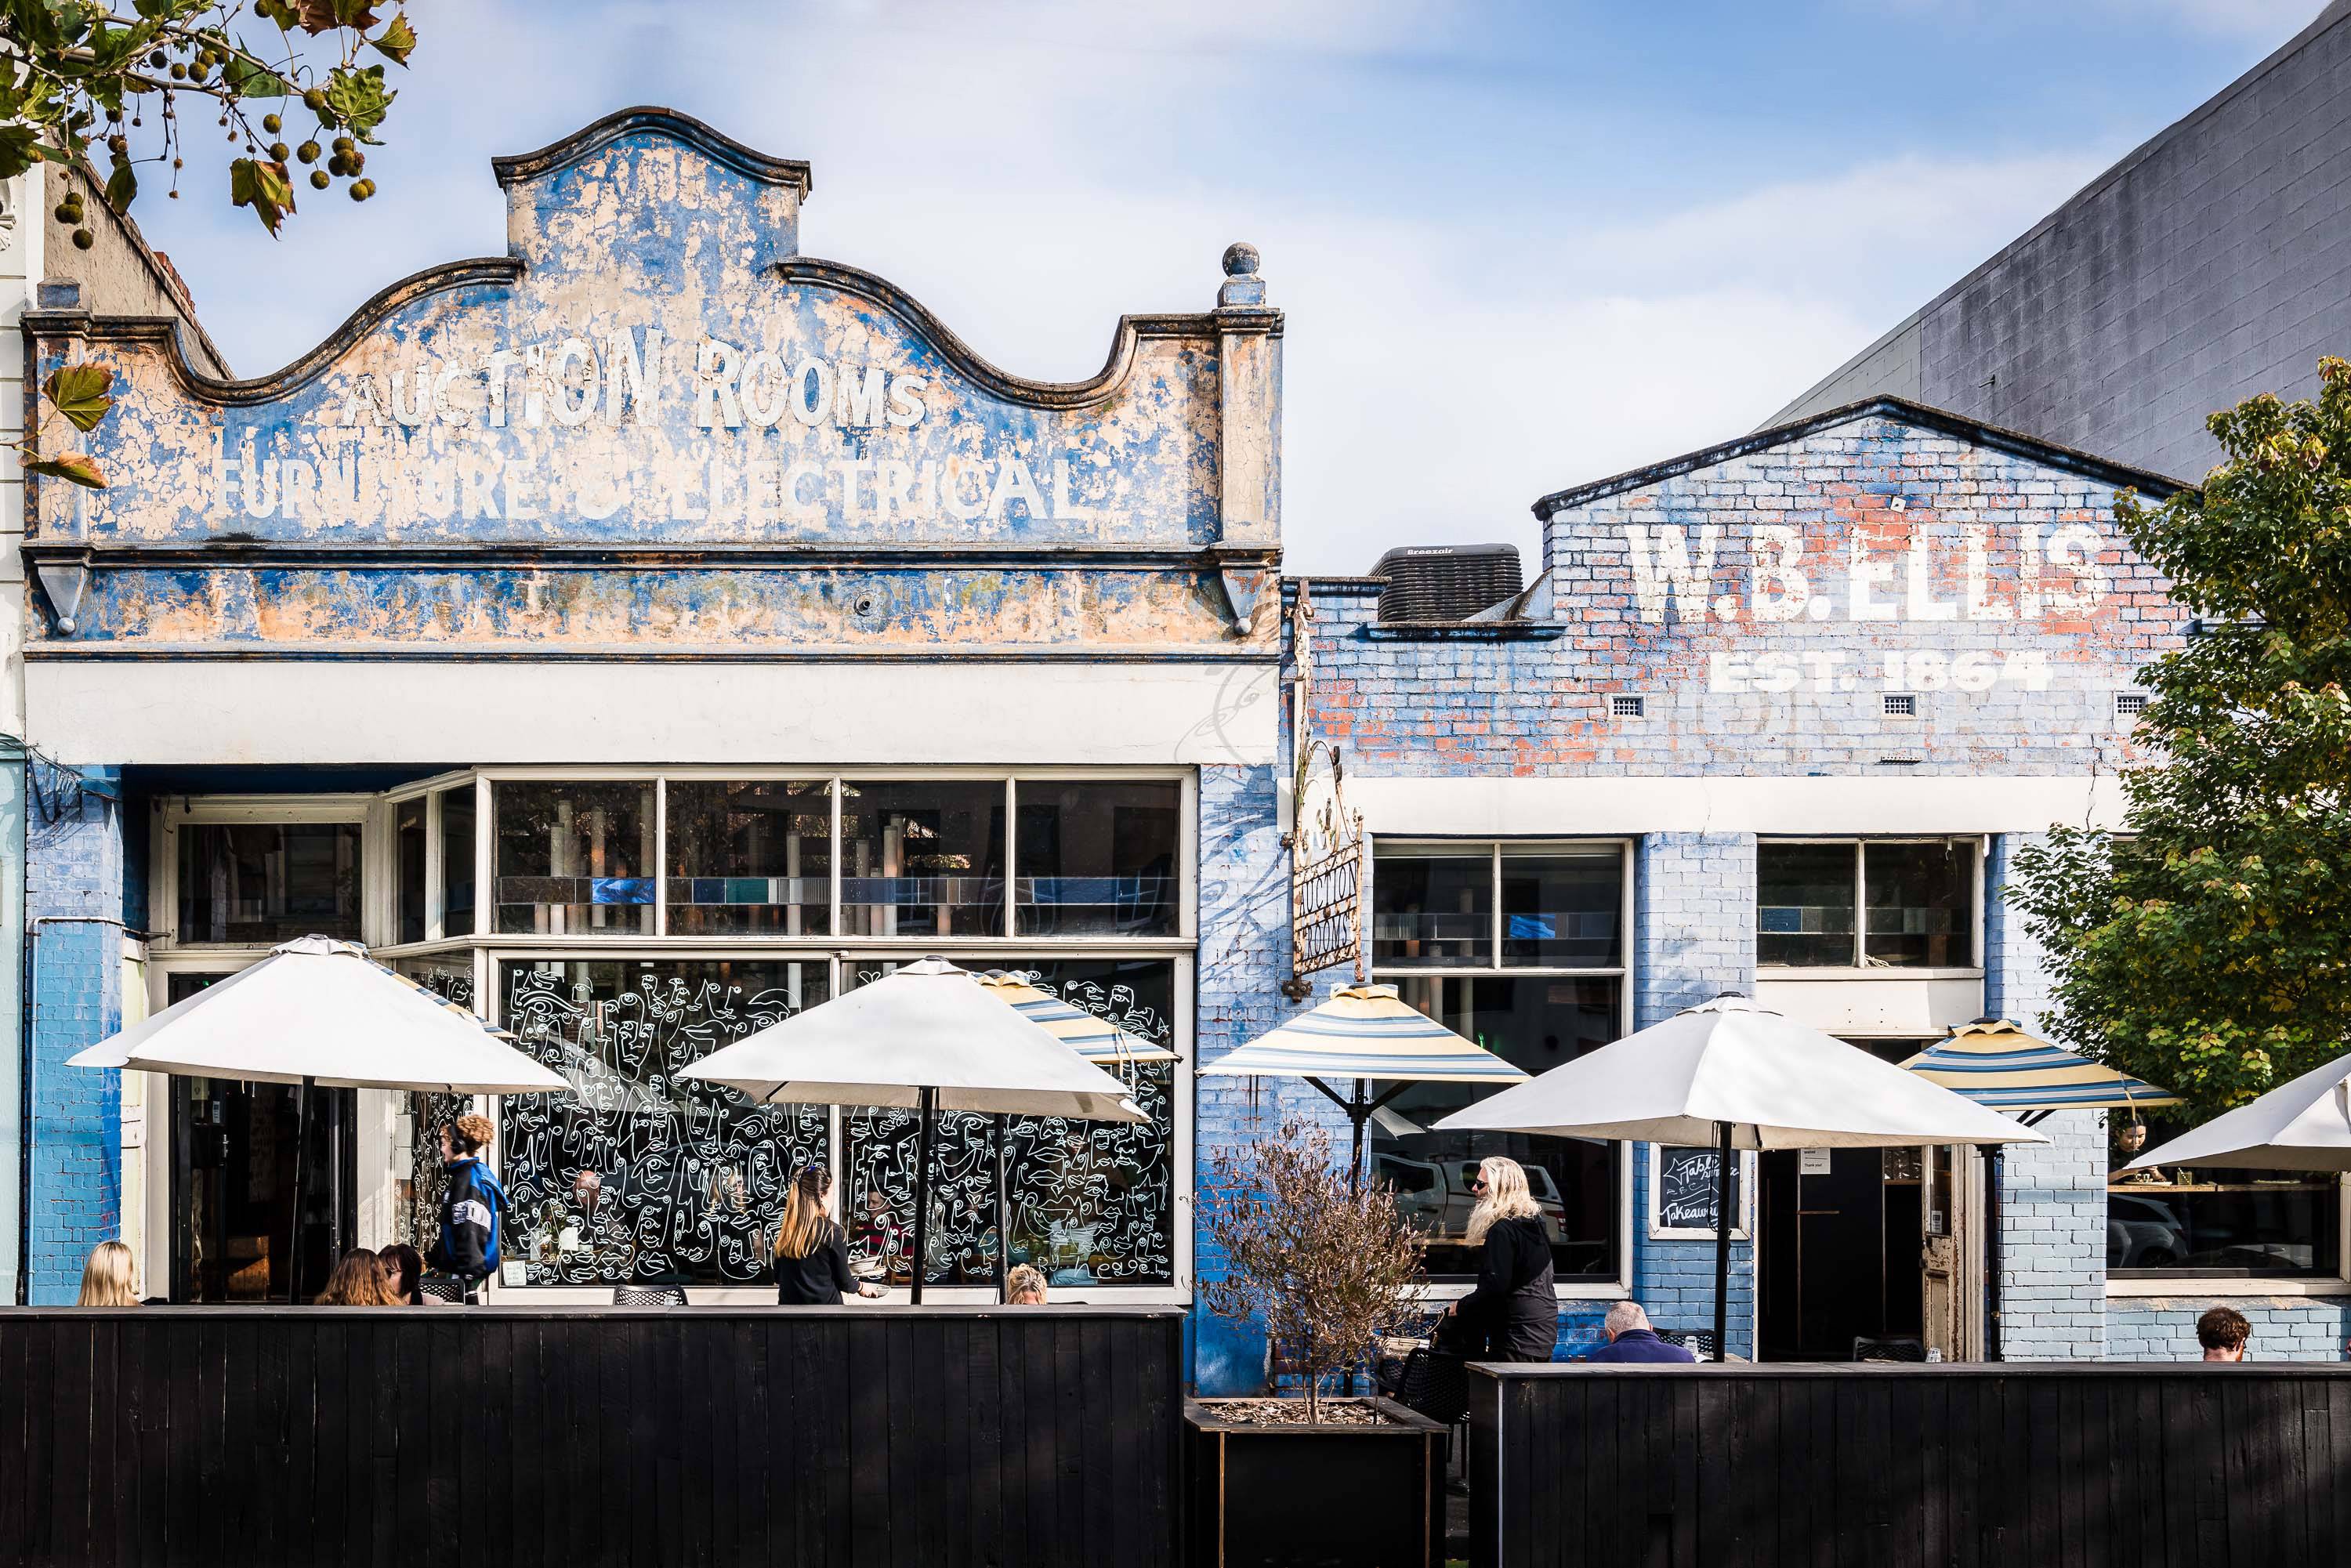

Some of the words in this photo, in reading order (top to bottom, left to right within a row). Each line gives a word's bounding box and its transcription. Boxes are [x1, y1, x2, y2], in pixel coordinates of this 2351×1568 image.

[342, 327, 663, 427] AUCTION
[697, 335, 927, 427] ROOMS
[216, 458, 538, 520] FURNIURE
[1709, 650, 1856, 693] EST.
[1883, 650, 2055, 693] 1864
[1299, 857, 1357, 916] AUCTION
[1306, 911, 1348, 958] ROOMS
